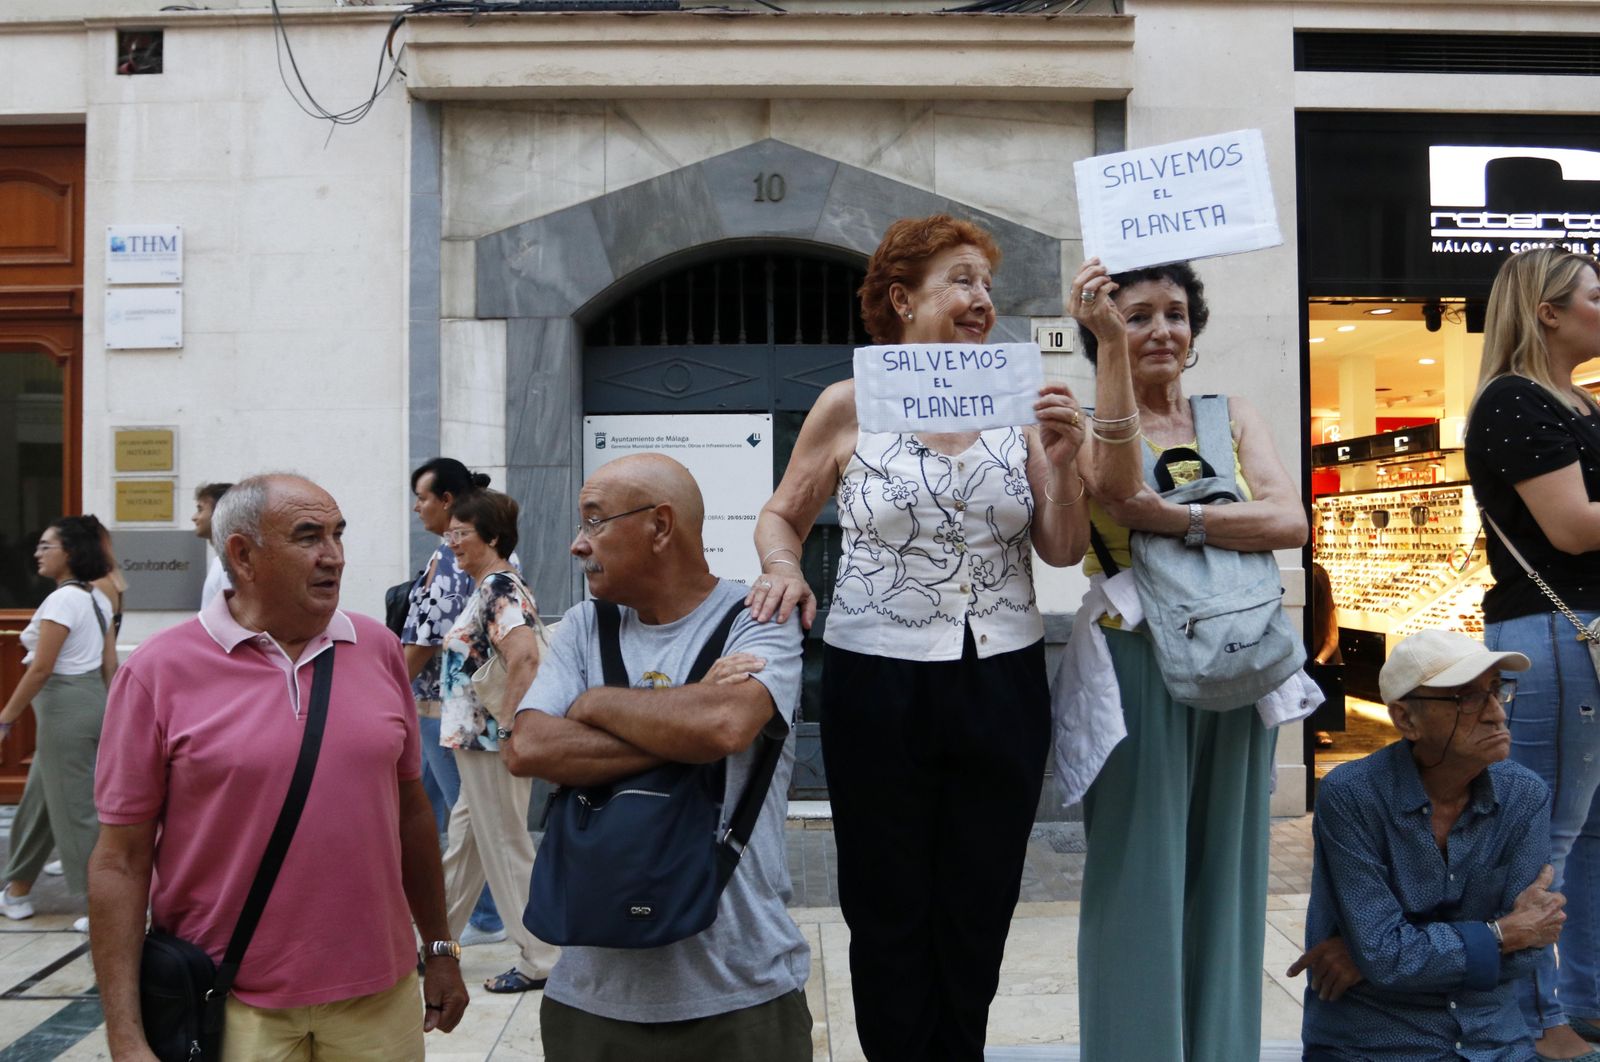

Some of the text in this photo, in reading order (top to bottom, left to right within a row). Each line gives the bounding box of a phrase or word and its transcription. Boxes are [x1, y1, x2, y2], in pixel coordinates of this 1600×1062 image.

[1103, 143, 1243, 188] SALVEMOS
[753, 172, 786, 203] 10
[1153, 189, 1173, 200] EL
[1121, 204, 1226, 240] PLANETA
[128, 235, 176, 253] THM
[1431, 239, 1492, 253] MÁLAGA
[1048, 332, 1063, 347] 10
[883, 349, 1008, 372] SALVEMOS
[933, 377, 953, 388] EL
[903, 394, 995, 419] PLANETA
[611, 435, 655, 444] Ayuntamiento
[665, 434, 689, 443] Málaga
[123, 558, 190, 571] Santander
